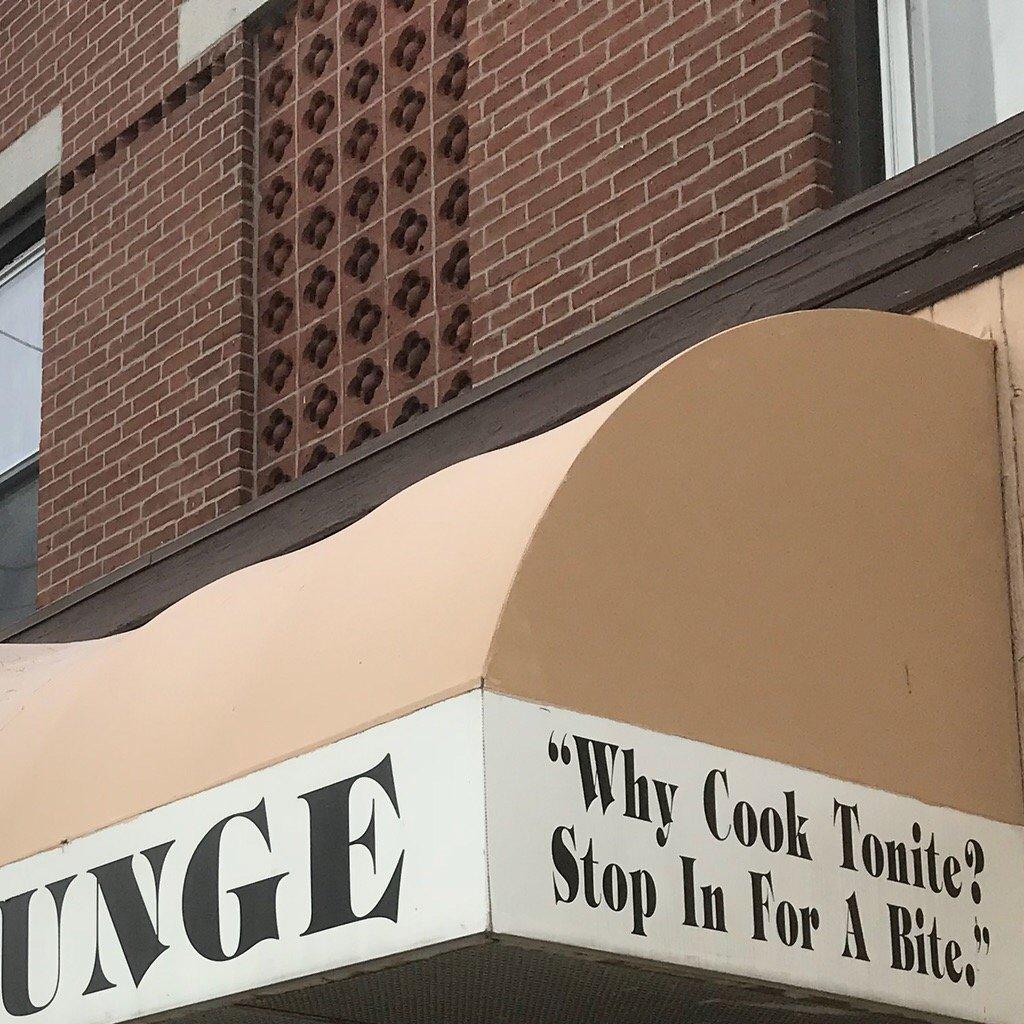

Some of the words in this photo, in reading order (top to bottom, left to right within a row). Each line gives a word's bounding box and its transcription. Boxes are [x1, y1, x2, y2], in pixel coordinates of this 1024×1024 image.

[551, 824, 657, 937] Stop
[678, 855, 728, 934] In
[748, 869, 821, 952] For
[841, 891, 871, 963] A
[702, 768, 813, 862] Cook
[833, 797, 985, 905] Tonite?
